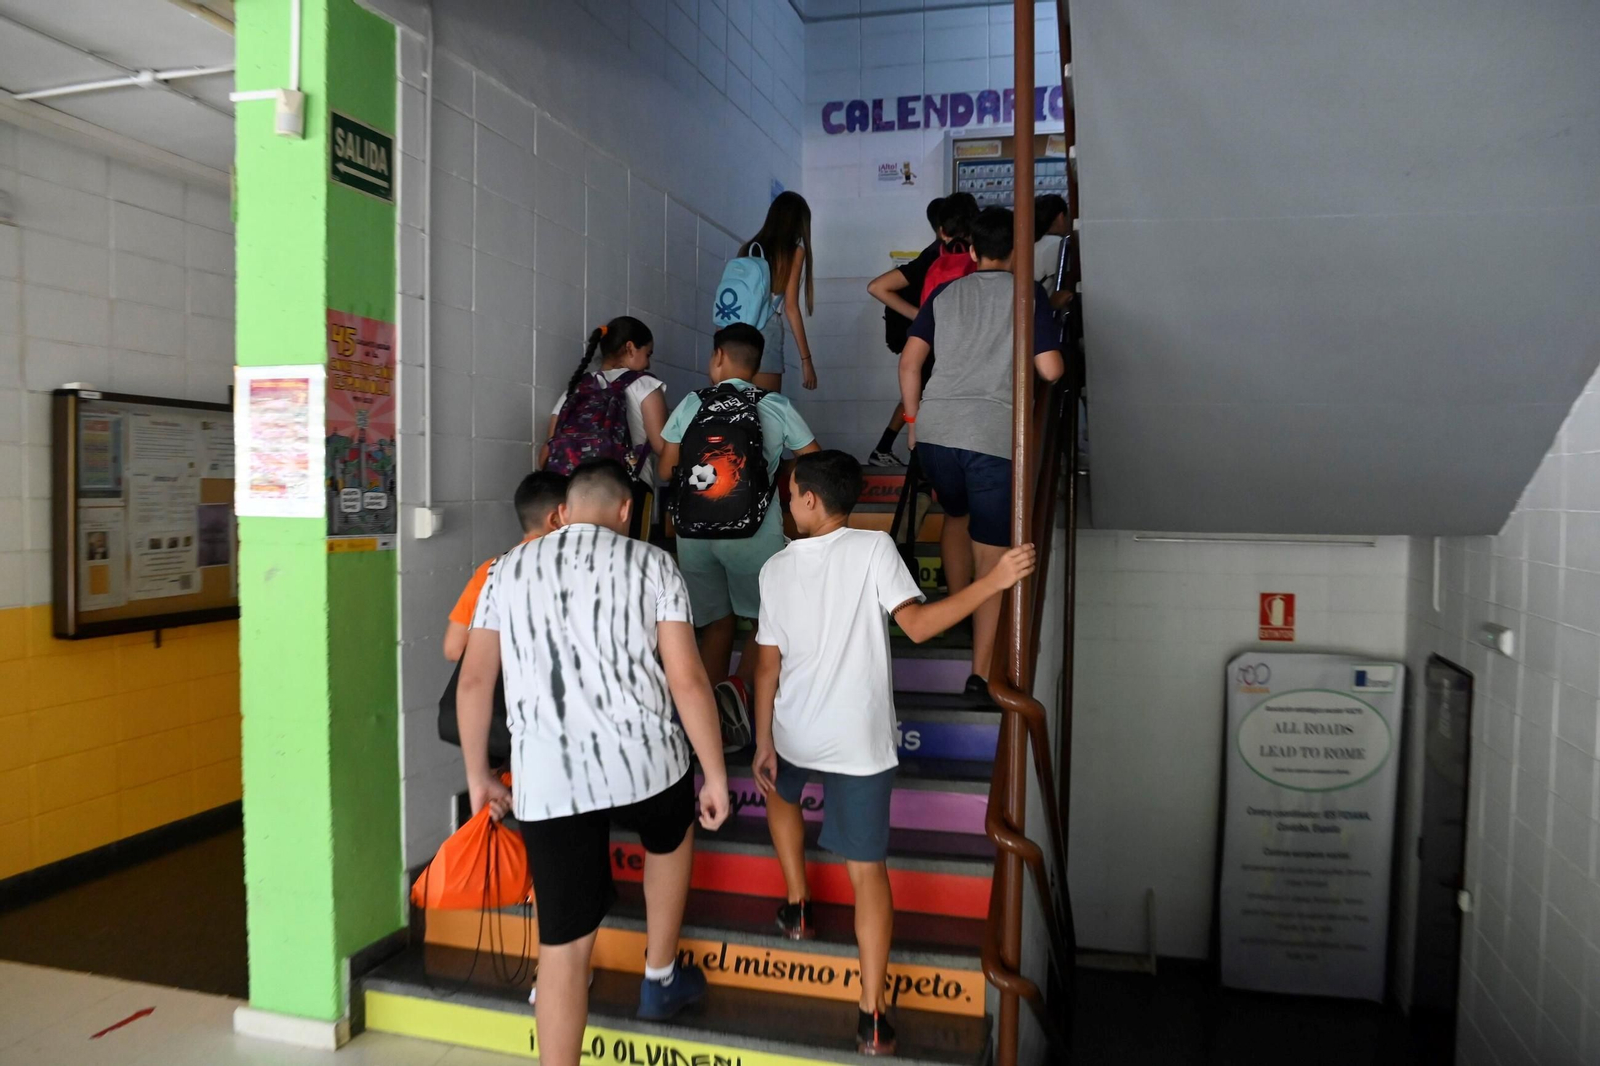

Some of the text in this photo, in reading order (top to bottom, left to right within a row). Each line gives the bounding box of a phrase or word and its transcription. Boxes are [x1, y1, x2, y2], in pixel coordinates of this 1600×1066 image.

[334, 127, 389, 176] SALIDA
[331, 323, 357, 358] 45
[1273, 722, 1355, 736] ALL ROADS
[1259, 744, 1367, 761] LEAD TO ROME
[702, 942, 730, 973] el
[734, 951, 839, 985] mismo
[843, 967, 972, 1006] rspeto.
[580, 1035, 606, 1061] O
